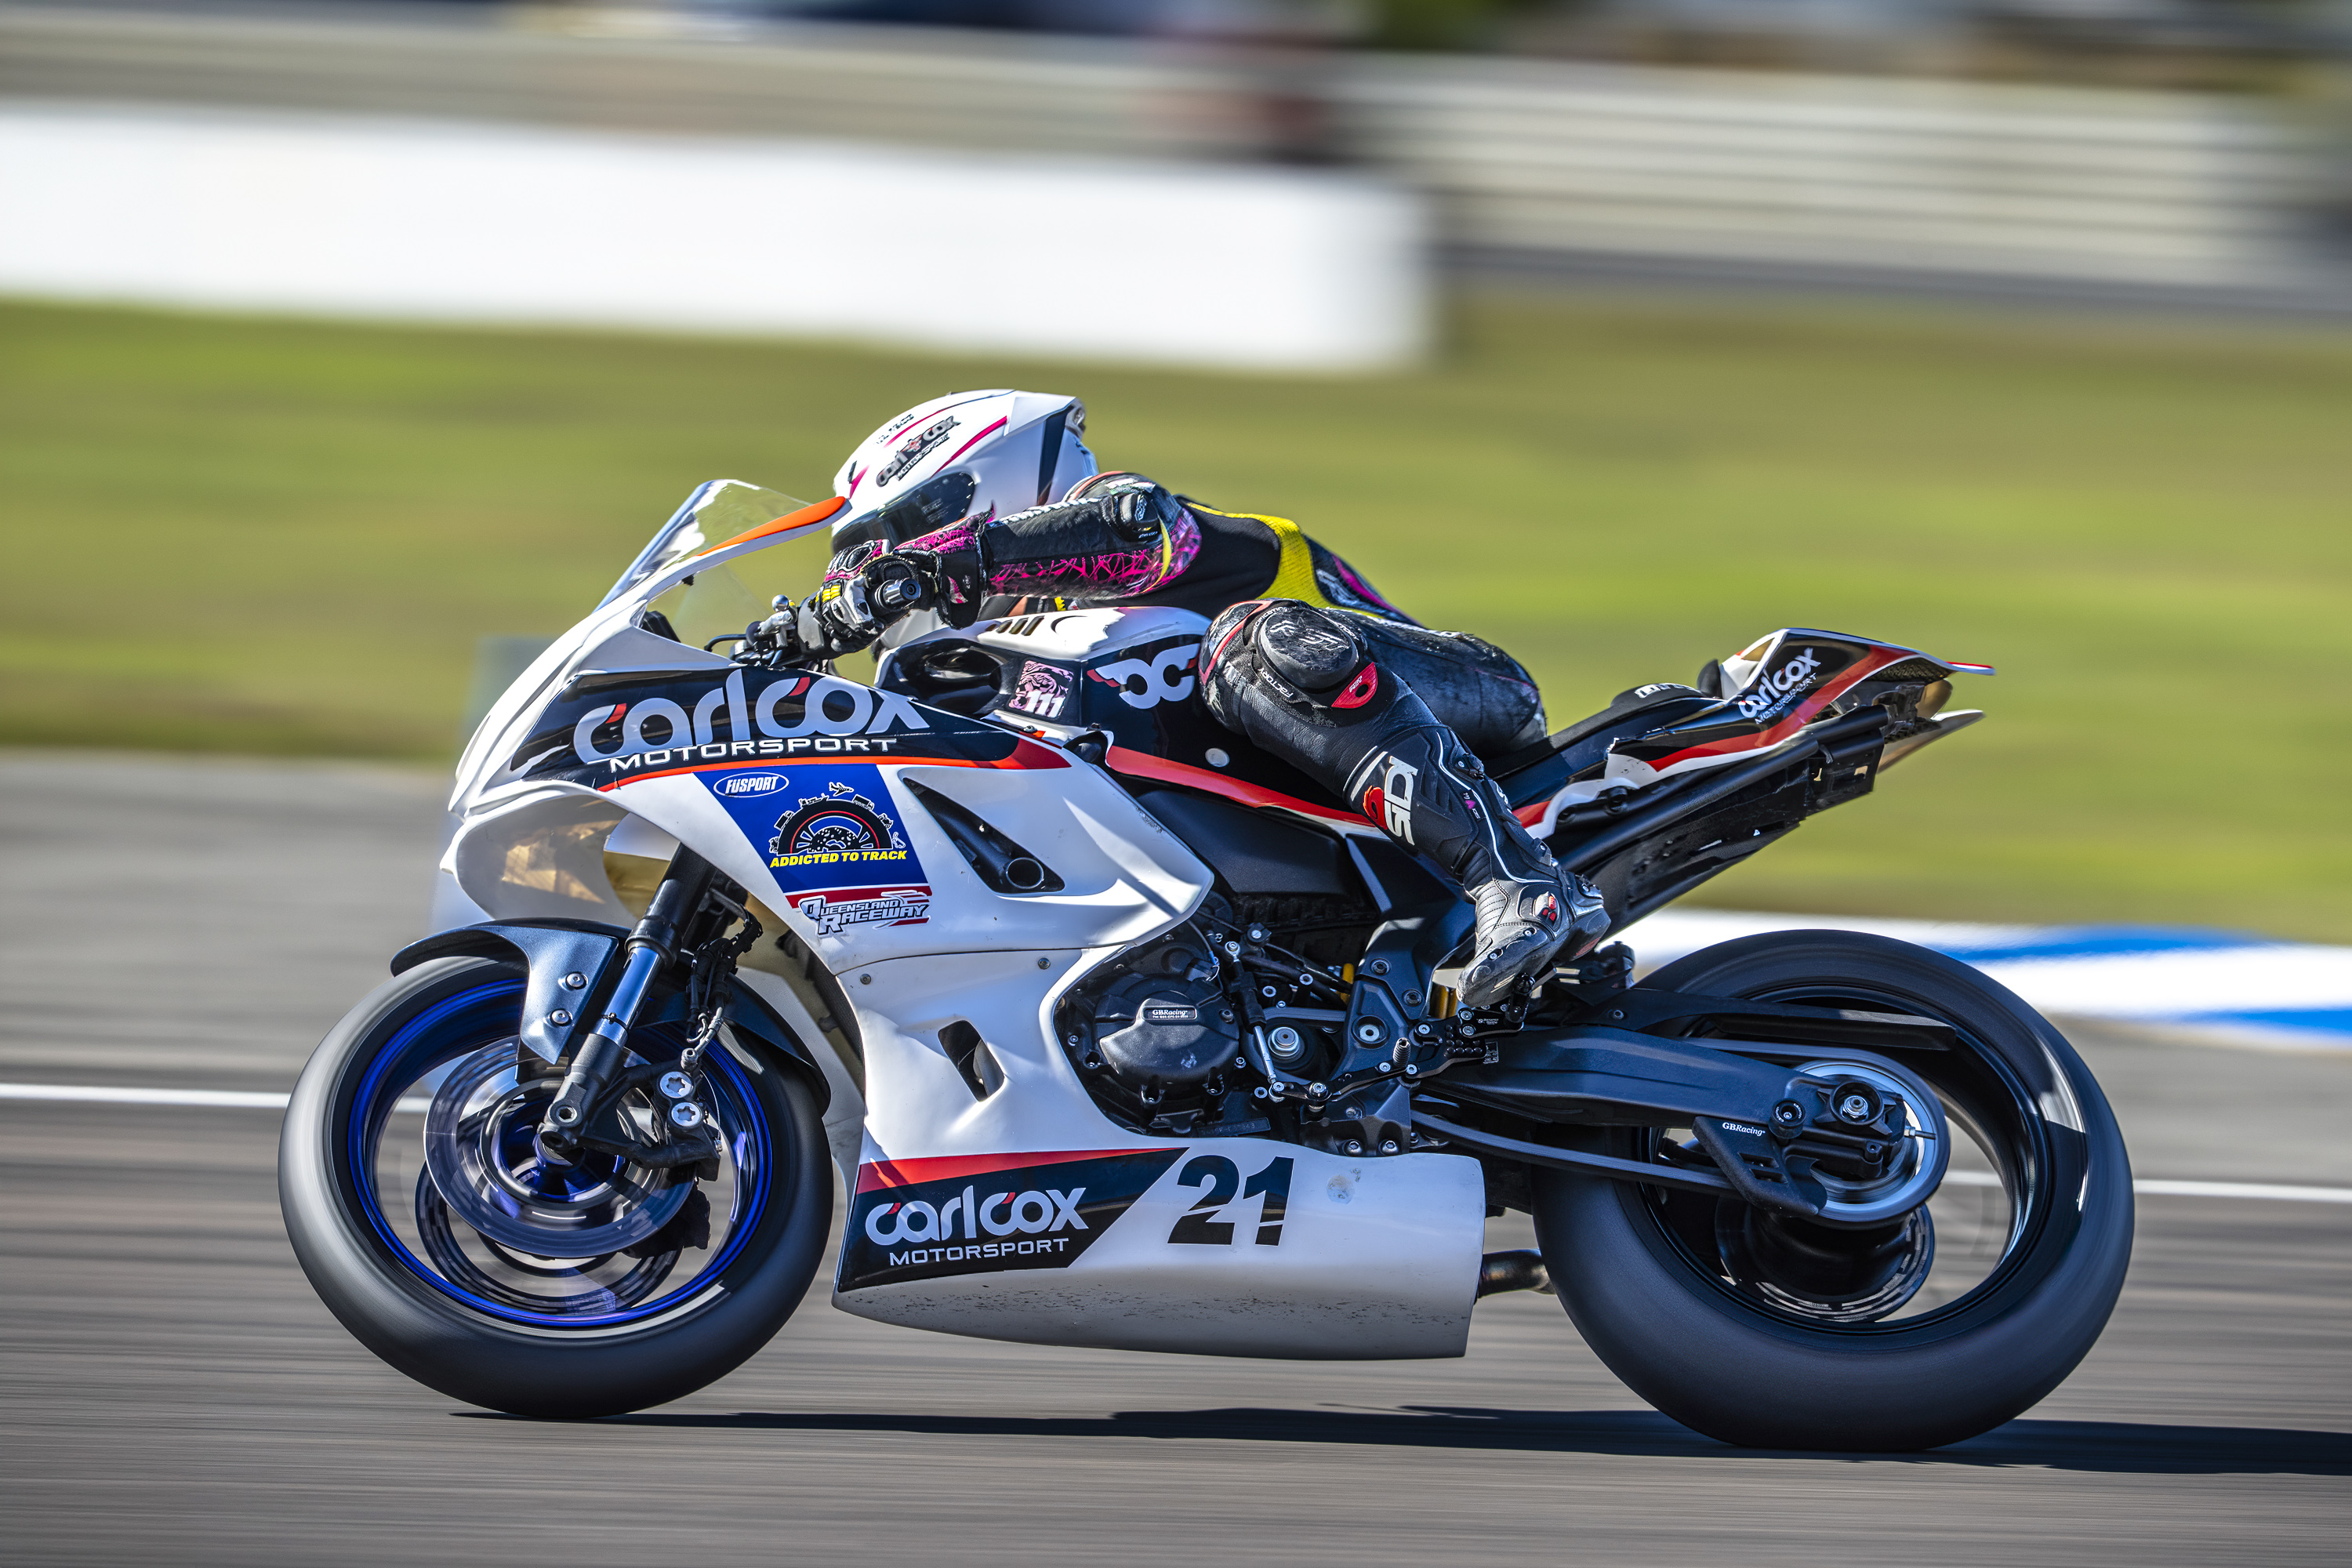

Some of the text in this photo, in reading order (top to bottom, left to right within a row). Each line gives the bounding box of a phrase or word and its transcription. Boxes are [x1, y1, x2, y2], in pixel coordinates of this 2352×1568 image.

[1025, 690, 1065, 717] 111
[1755, 673, 1817, 724] MOTORSPORT
[610, 738, 898, 773] MOTORSPORT
[770, 850, 907, 868] ADDICTED TO TRACK
[800, 898, 900, 920] QUEENSLAND
[818, 905, 929, 935] RACEWAY
[1722, 1122, 1764, 1137] GBRacing
[1167, 1155, 1294, 1247] 21
[889, 1238, 1069, 1265] MOTORSPORT
